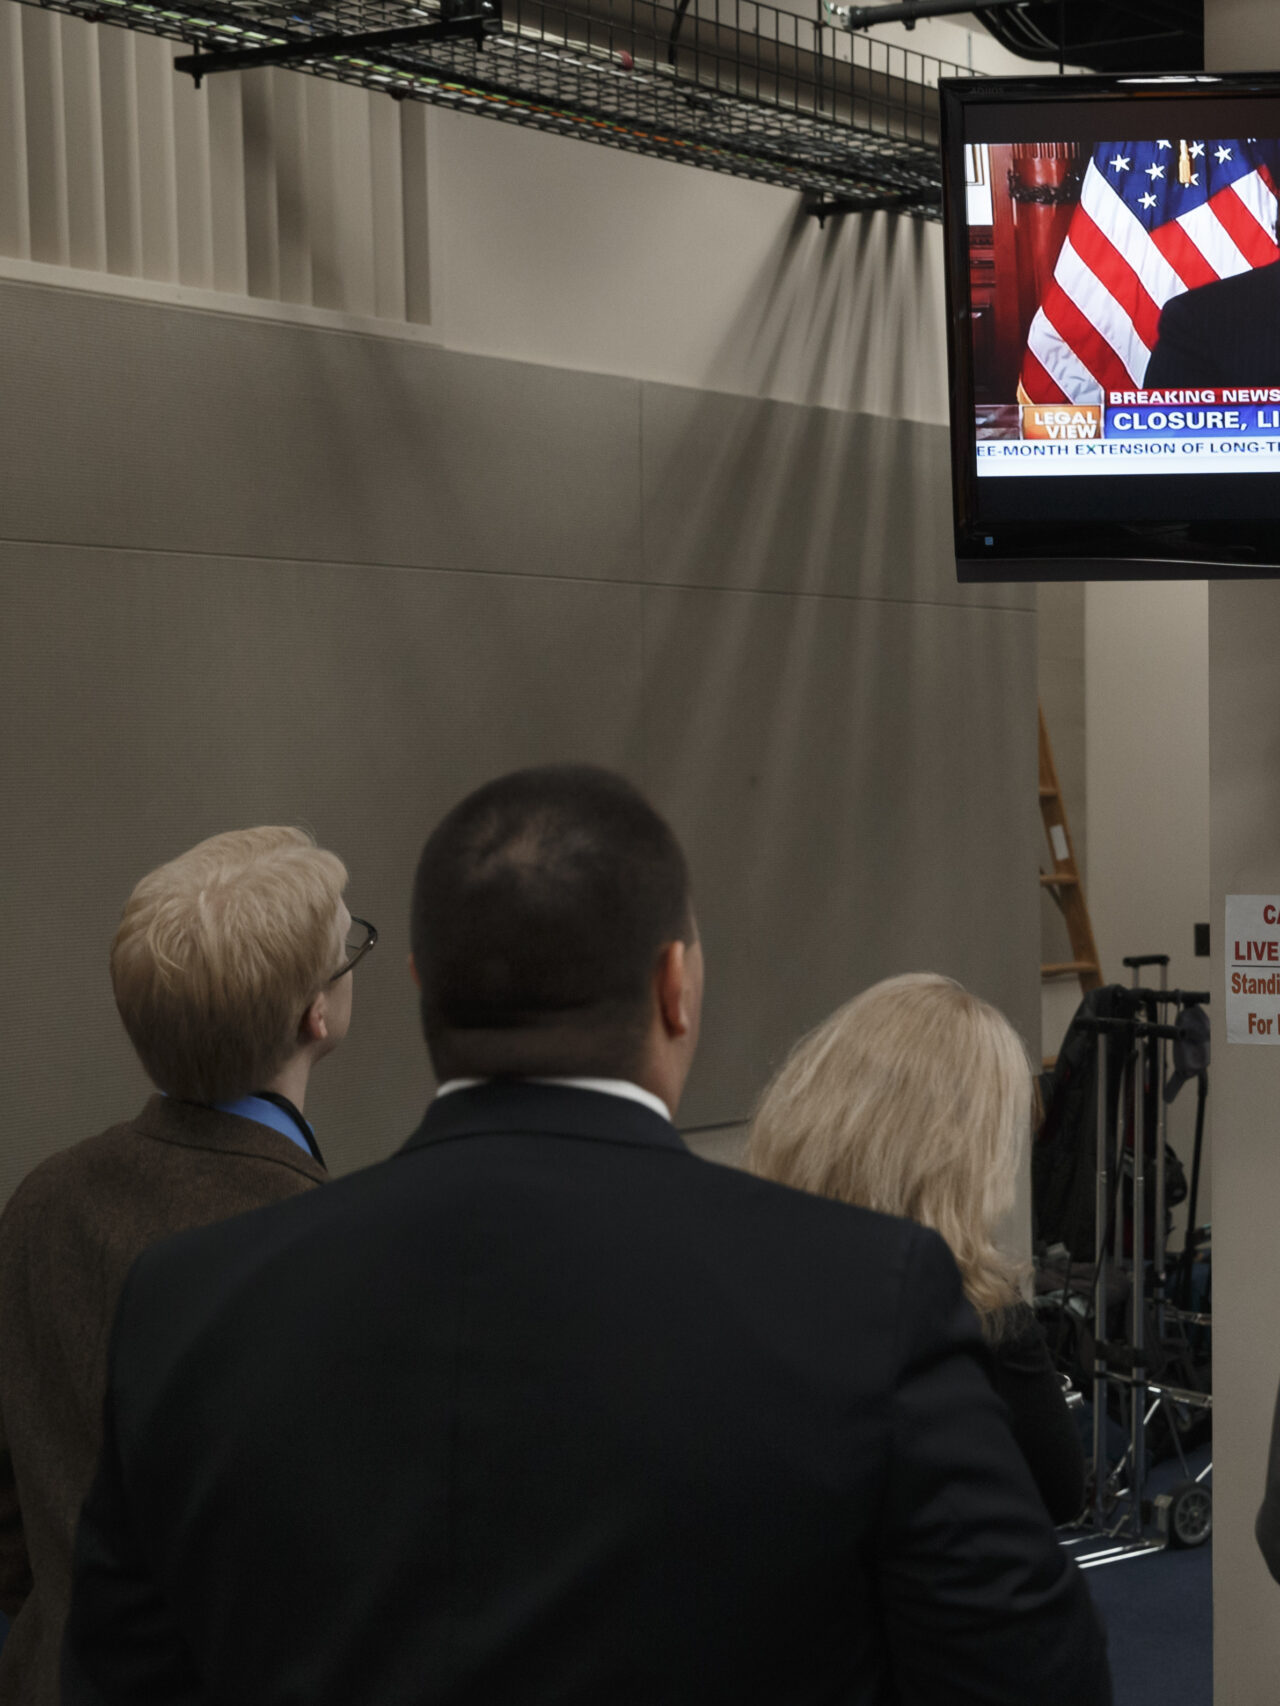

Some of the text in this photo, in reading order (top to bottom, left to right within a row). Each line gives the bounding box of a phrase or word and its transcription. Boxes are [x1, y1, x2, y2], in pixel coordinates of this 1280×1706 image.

[1109, 390, 1215, 404] BREAKING
[1034, 411, 1097, 425] LEGAL
[1113, 411, 1247, 431] CLOSURE,
[1045, 424, 1097, 439] VIEW
[976, 445, 1069, 457] EE-MONTH
[1075, 443, 1175, 455] EXTENSION
[1181, 442, 1204, 454] OF
[1234, 941, 1279, 961] LIVE
[1248, 1013, 1273, 1035] For
